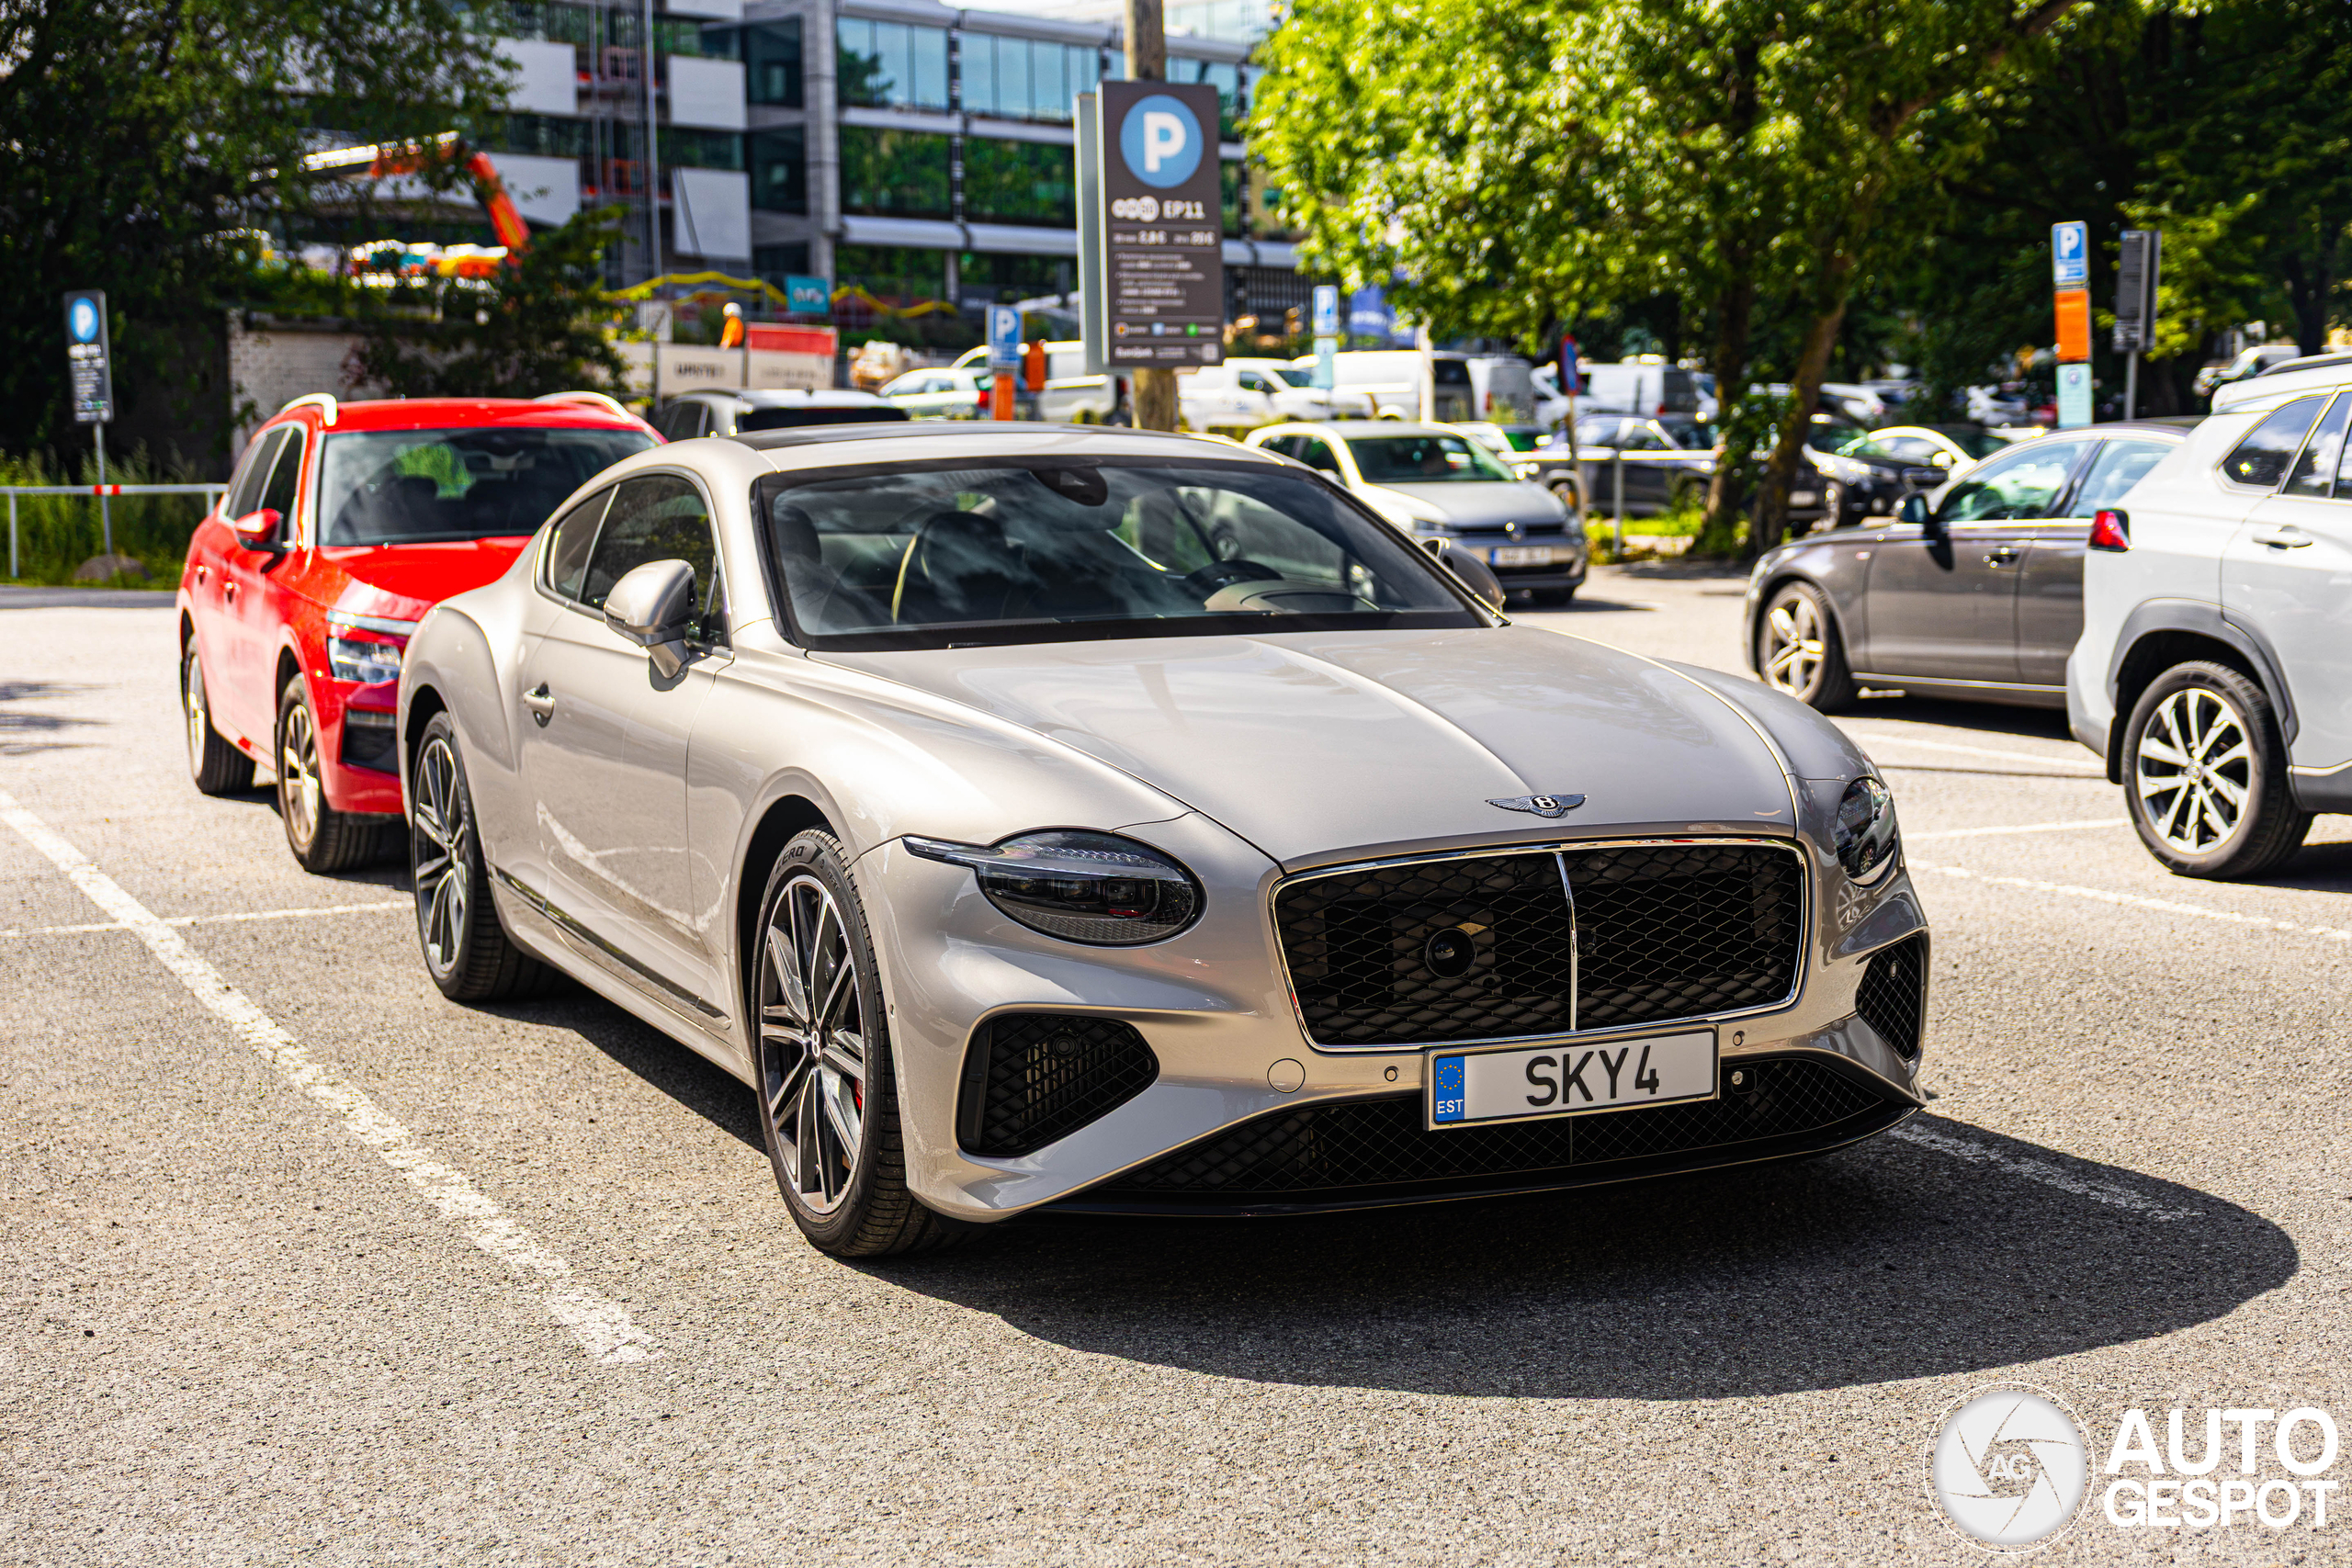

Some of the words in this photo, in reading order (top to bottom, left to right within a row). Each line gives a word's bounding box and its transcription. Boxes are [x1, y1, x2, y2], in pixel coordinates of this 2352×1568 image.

[1143, 111, 1186, 173] P
[1162, 199, 1205, 219] EP11
[2059, 227, 2079, 258] P
[74, 304, 94, 337] P
[995, 310, 1017, 340] P
[1525, 1045, 1660, 1107] SKY4
[1437, 1099, 1464, 1114] EST
